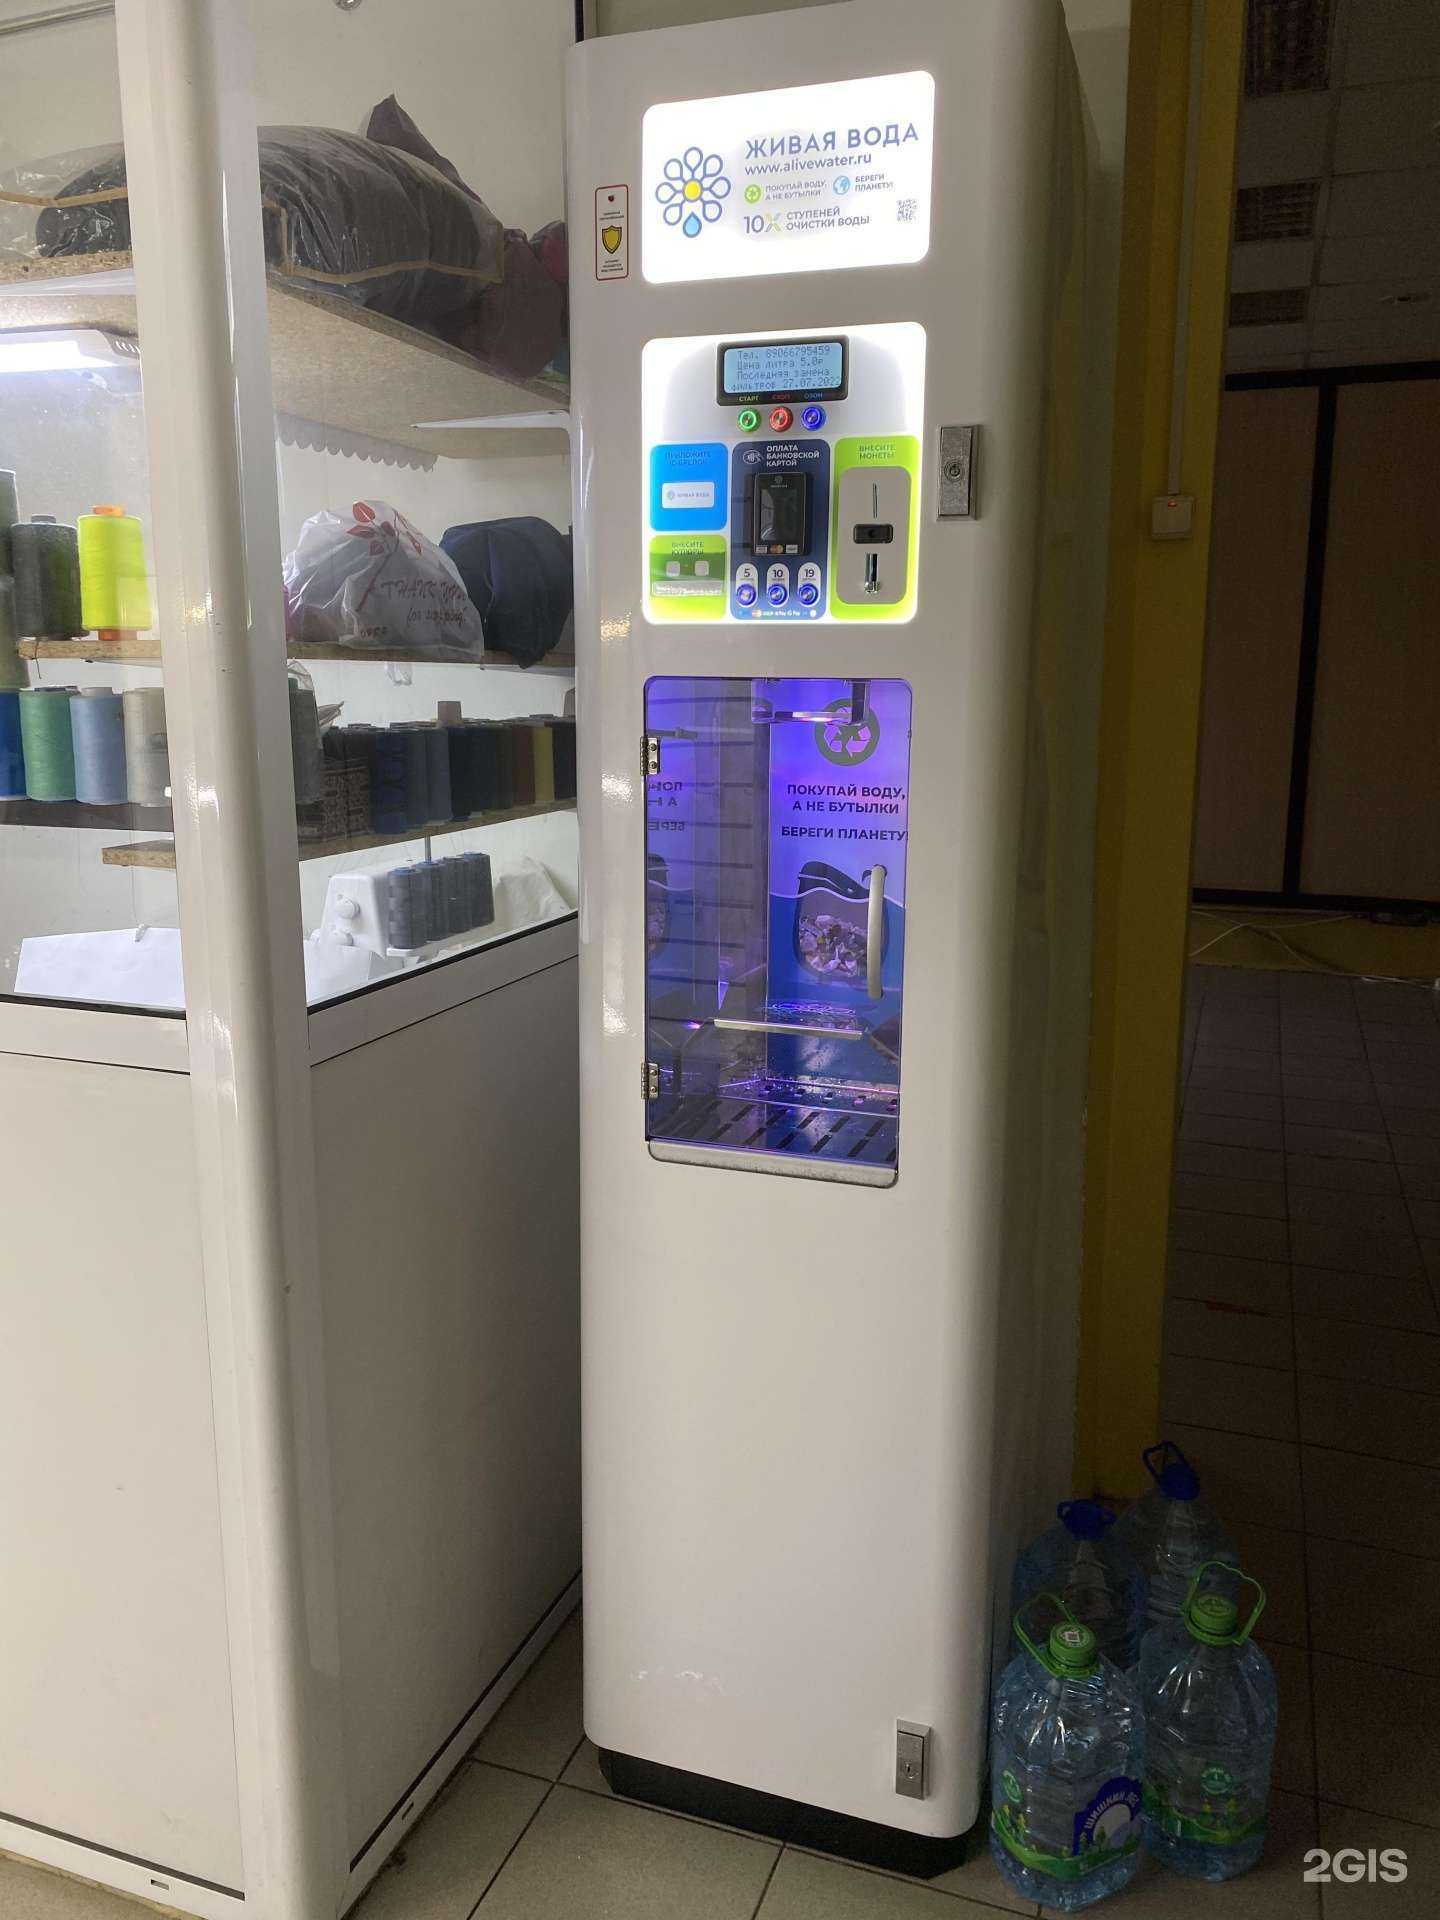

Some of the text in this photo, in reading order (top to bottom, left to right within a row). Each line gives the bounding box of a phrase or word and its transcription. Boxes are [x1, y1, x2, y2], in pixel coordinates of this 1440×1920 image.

[745, 122, 919, 159] ЖИВАЯ ВОДА
[745, 153, 872, 176] www.alivewater.ru
[855, 173, 884, 183] БЕРЕГИ
[766, 181, 803, 192] ПОКУПАЙ
[772, 193, 783, 201] НЕ
[785, 189, 821, 200] БУТЫЛКИ
[786, 206, 841, 220] СТУПЕНЕЙ
[786, 215, 870, 231] ОЧИСТКИ ВОДЫ
[766, 444, 799, 452] ОПЛАТА
[766, 450, 820, 460] БАНКОВСКОЙ
[766, 459, 798, 467] КАРТОЙ
[744, 568, 750, 577] 5
[773, 569, 783, 578] 10
[805, 568, 814, 577] 19
[787, 783, 906, 800] ПОКУПАЙ ВОДУ,
[792, 800, 899, 814] А НЕ БУТЫЛКИ
[781, 826, 834, 838] БЕРЕГИ
